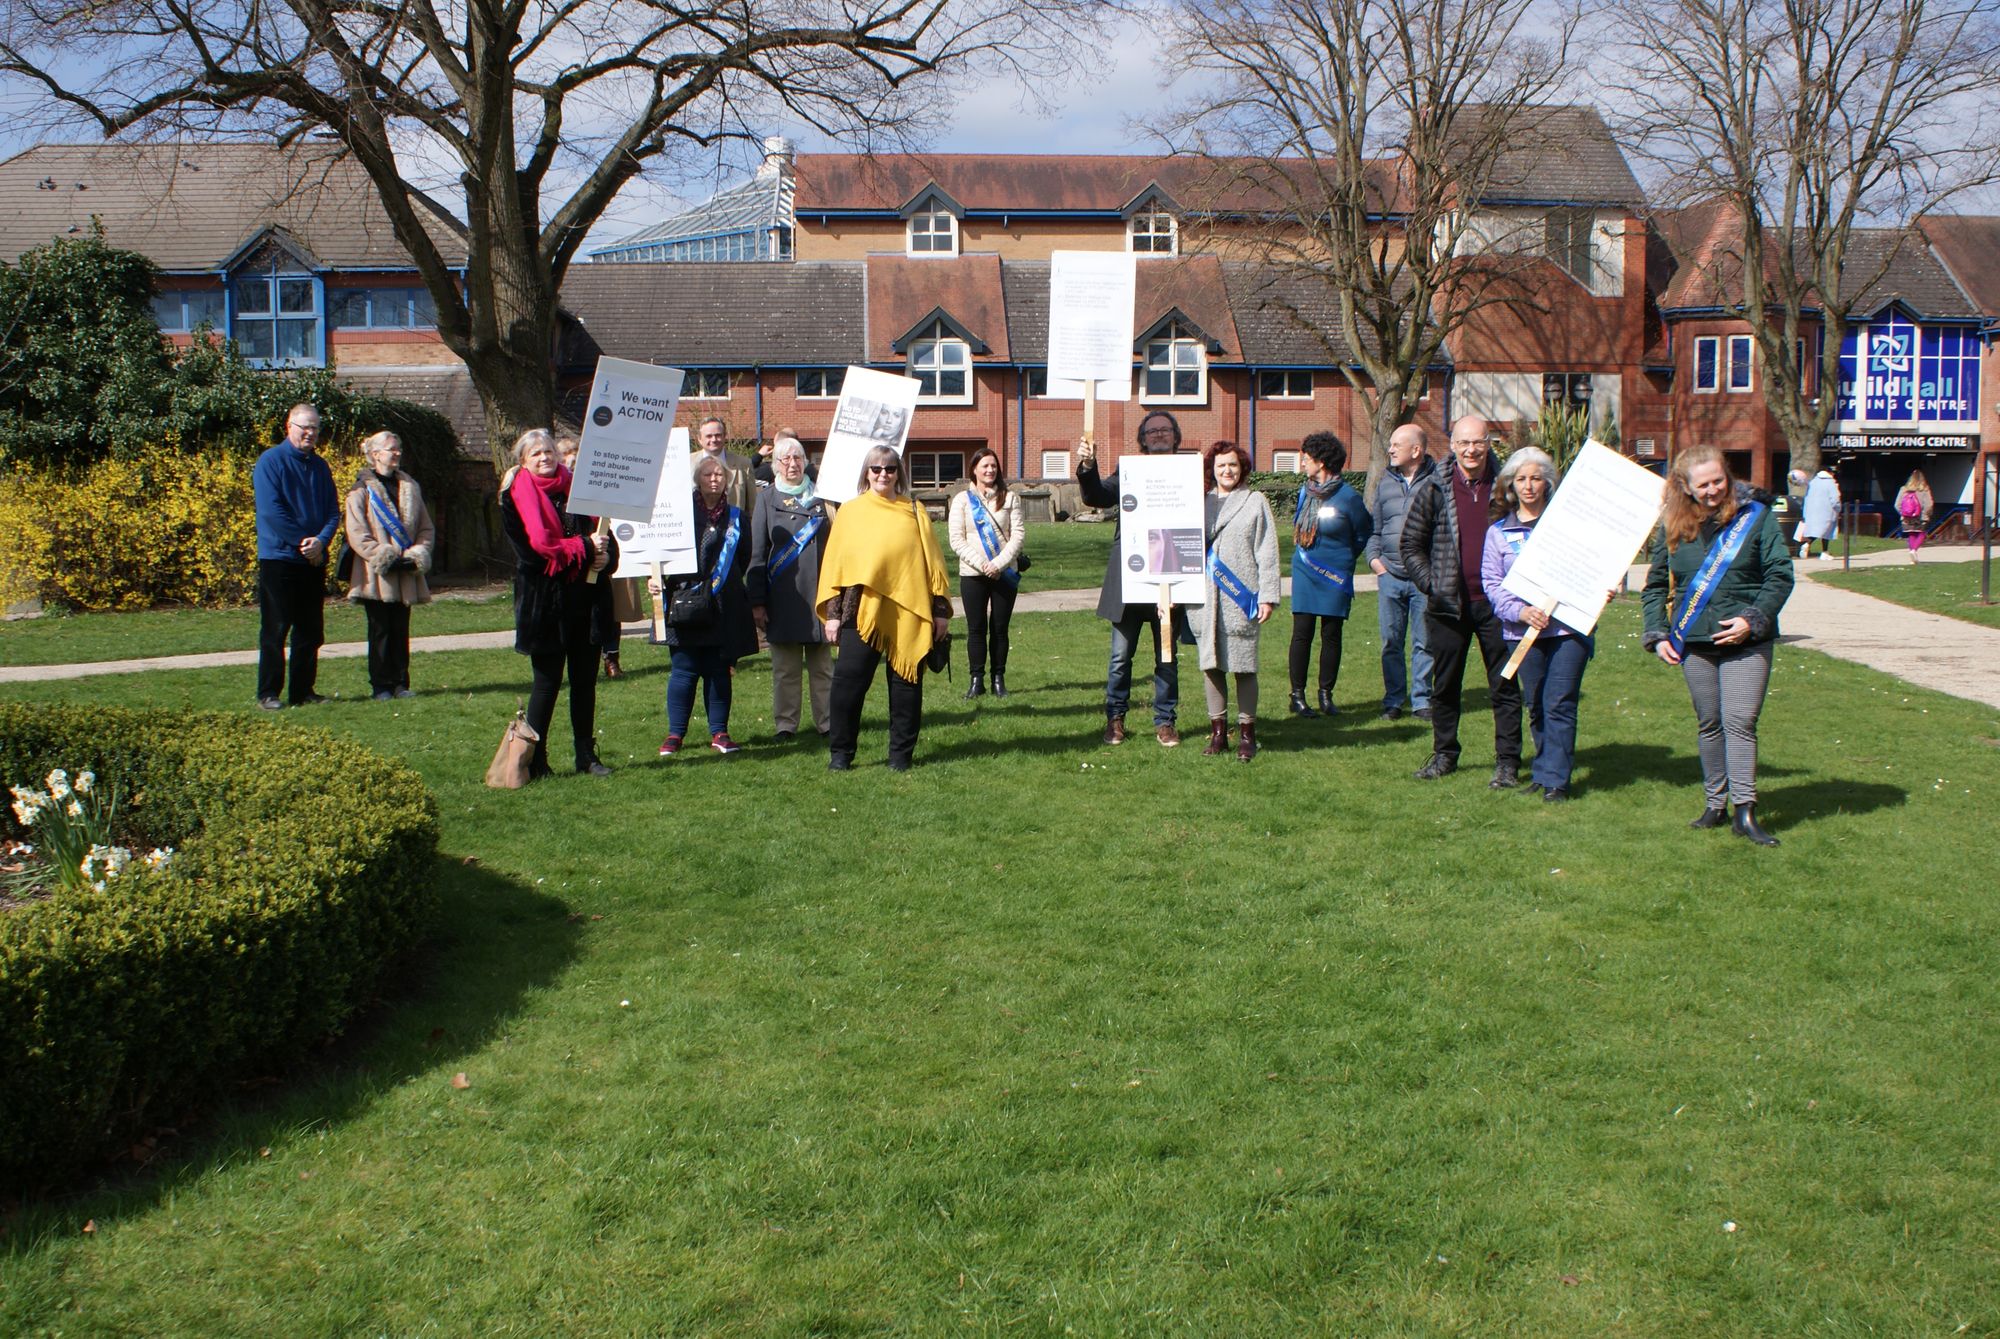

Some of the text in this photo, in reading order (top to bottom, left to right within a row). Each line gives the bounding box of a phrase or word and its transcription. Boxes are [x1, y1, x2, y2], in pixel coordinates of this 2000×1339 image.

[621, 390, 670, 409] We want
[1904, 399, 1967, 411] CENTRE
[617, 406, 664, 422] ACTION
[1869, 436, 1926, 447] SHOPPING
[1926, 436, 1967, 447] CENTRE
[603, 452, 620, 460] stop
[622, 454, 652, 465] violence
[591, 460, 630, 471] and abuse
[590, 470, 645, 483] against women
[588, 479, 620, 489] and girls
[1214, 570, 1241, 596] of Stafford
